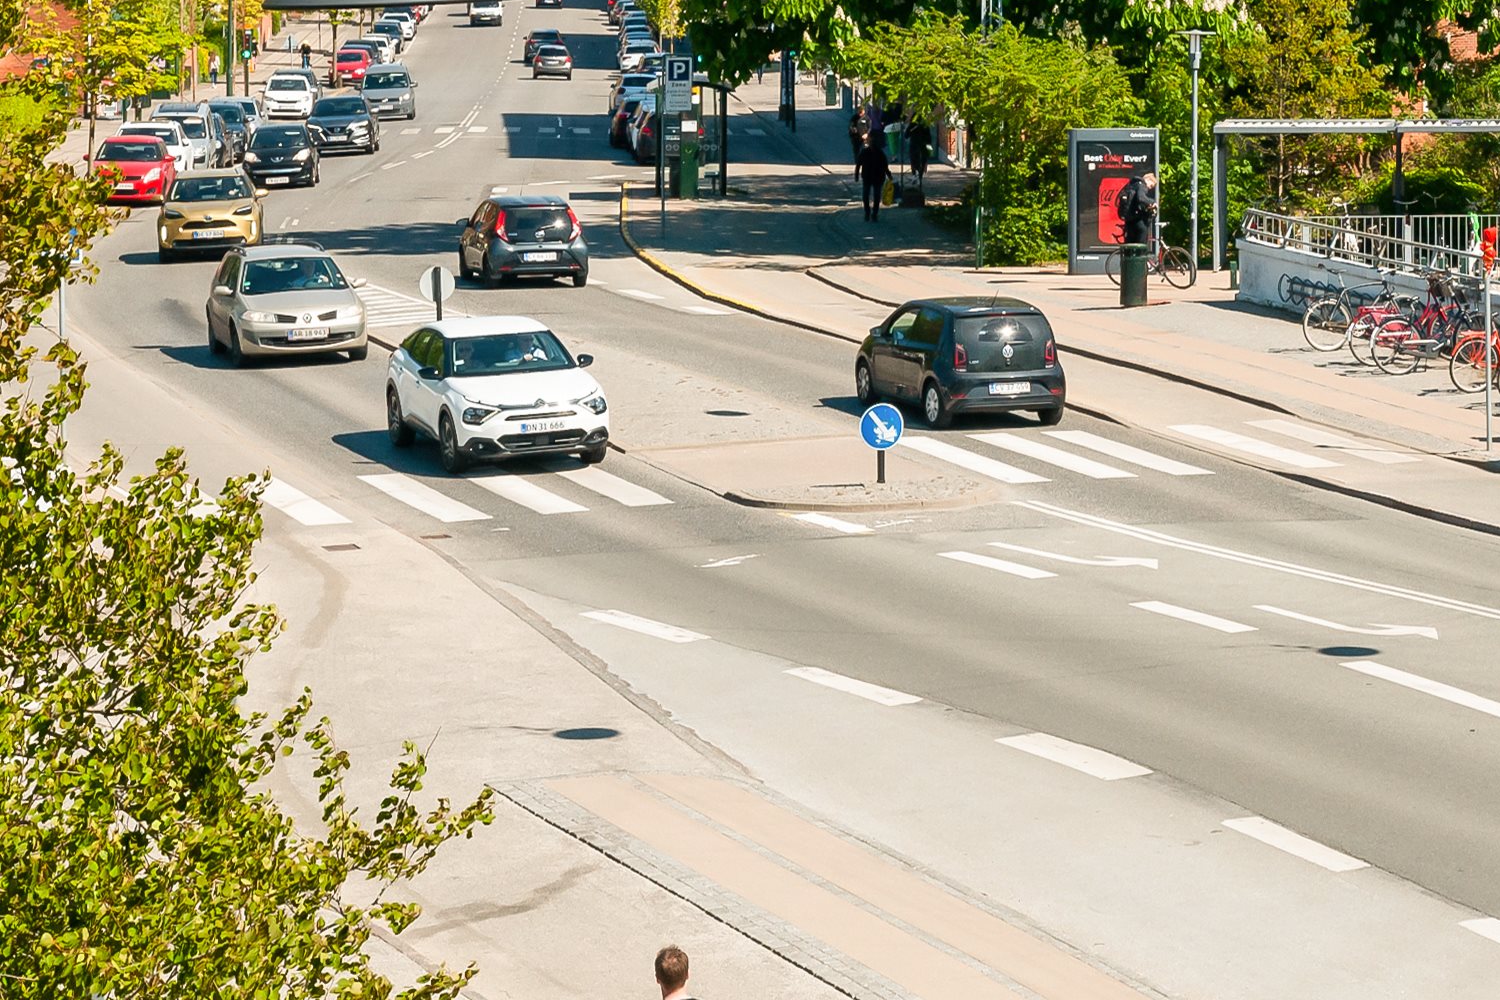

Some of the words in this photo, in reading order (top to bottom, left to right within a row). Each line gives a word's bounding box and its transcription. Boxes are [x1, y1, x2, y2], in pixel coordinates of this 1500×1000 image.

[673, 61, 686, 79] P
[1084, 154, 1103, 162] Best
[526, 423, 537, 431] DN
[538, 422, 547, 430] 31
